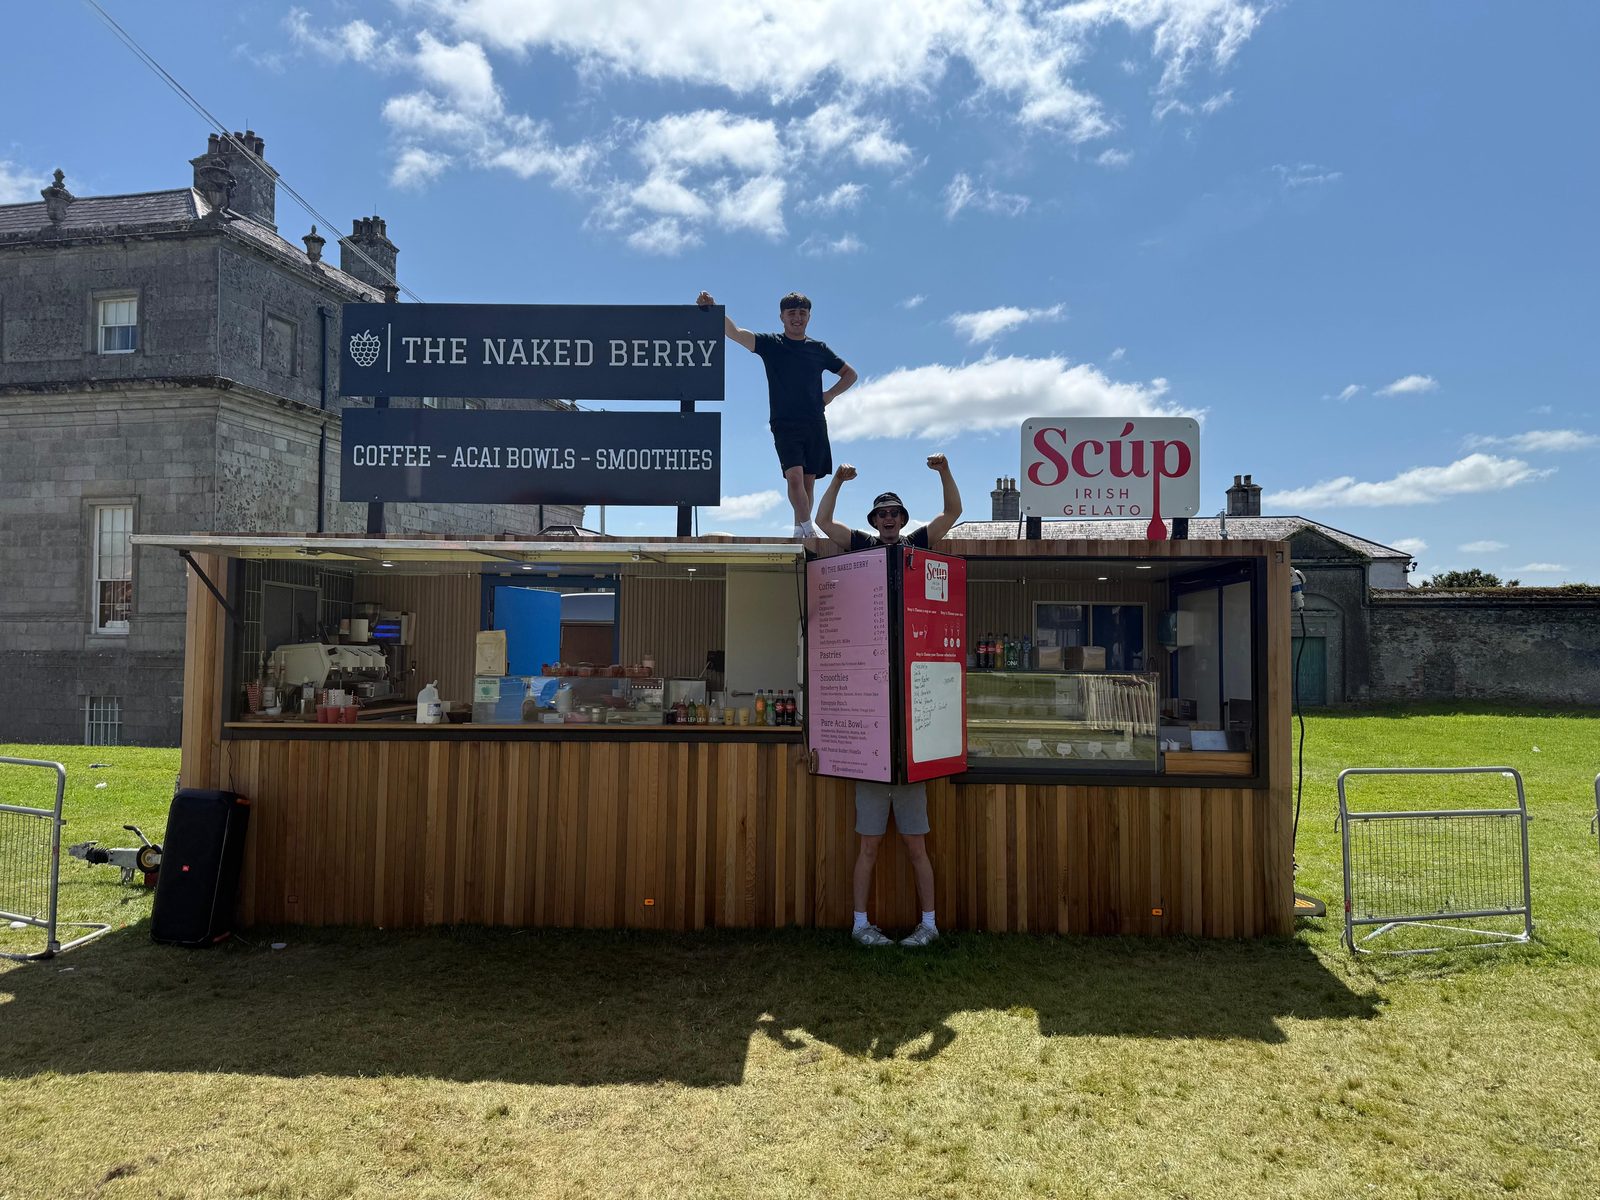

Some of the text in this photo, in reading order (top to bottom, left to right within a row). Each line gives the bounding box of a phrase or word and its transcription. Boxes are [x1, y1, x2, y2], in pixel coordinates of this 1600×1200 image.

[402, 337, 717, 367] THE NAKED BERRY
[353, 445, 431, 467] COFFEE
[451, 446, 500, 468] ACAI
[506, 447, 575, 469] BOWLS
[596, 448, 713, 470] SMOOTHIES
[1027, 422, 1192, 515] Scúp
[1075, 488, 1129, 499] IRISH
[1063, 504, 1141, 516] GELATO
[827, 560, 869, 573] THE NAKED BERRY
[818, 582, 836, 591] Coffee
[819, 651, 842, 659] Pastries
[820, 673, 849, 681] Smoothies
[848, 720, 863, 728] Bowl
